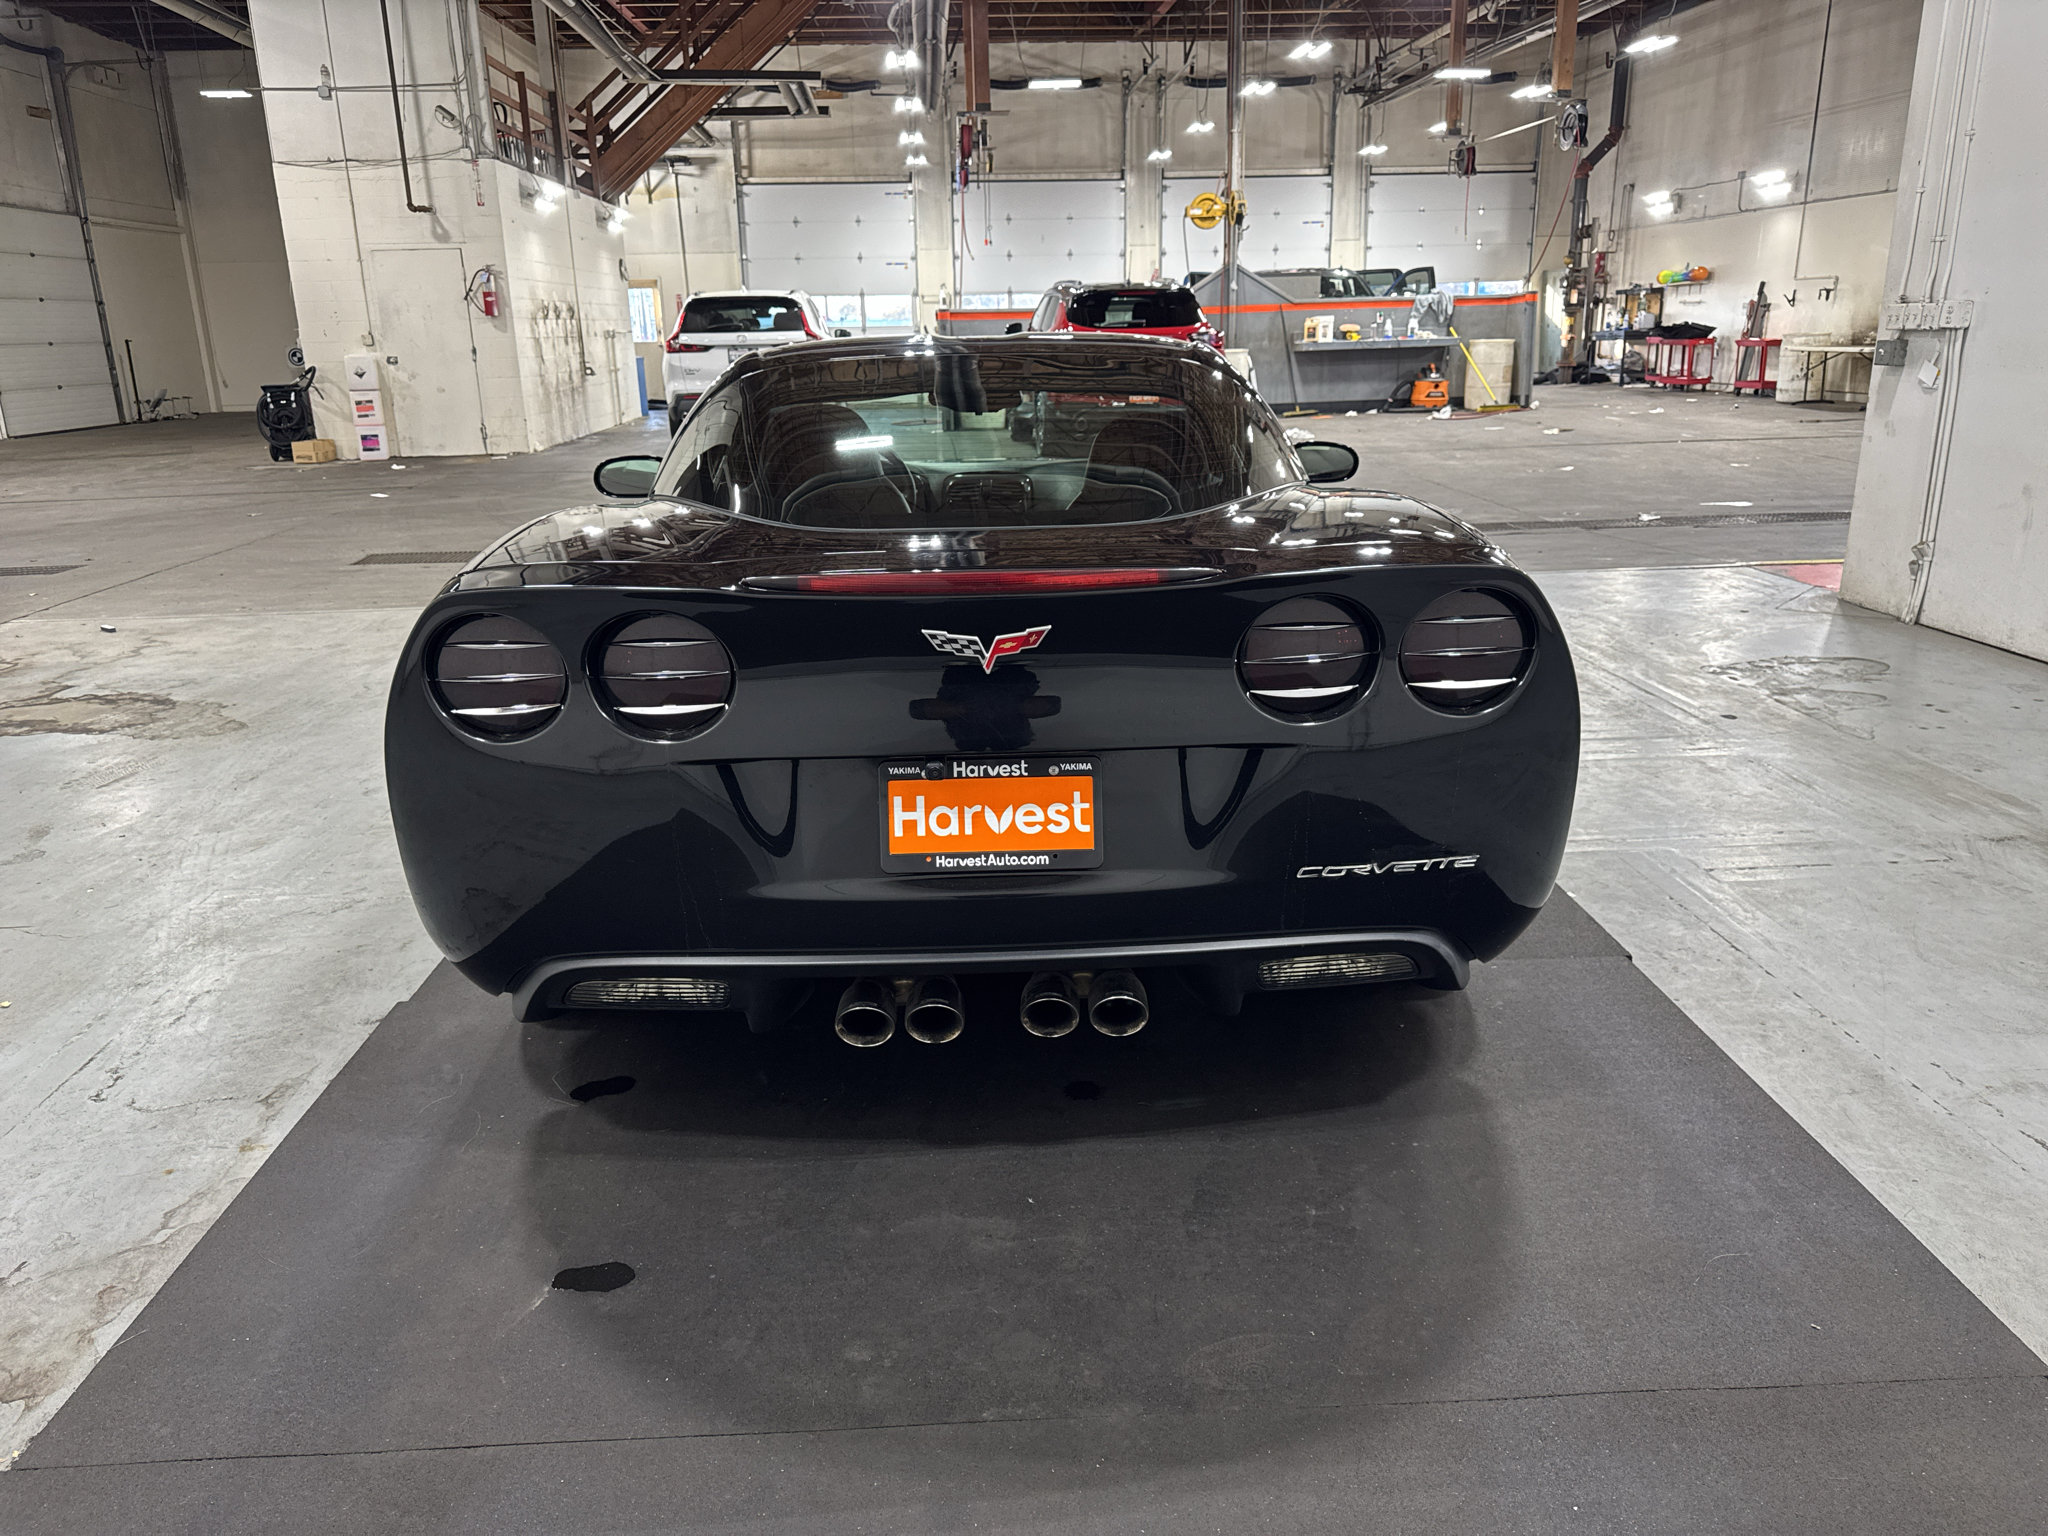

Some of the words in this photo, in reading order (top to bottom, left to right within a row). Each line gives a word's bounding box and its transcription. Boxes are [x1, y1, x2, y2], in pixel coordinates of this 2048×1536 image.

[888, 766, 921, 775] YAKIMA
[952, 759, 1029, 778] Harvest
[1059, 762, 1093, 771] YAKIMA
[892, 791, 1091, 837] Harvest
[935, 853, 1050, 868] HarvestAuto.com
[1296, 854, 1480, 878] CORVETTE
